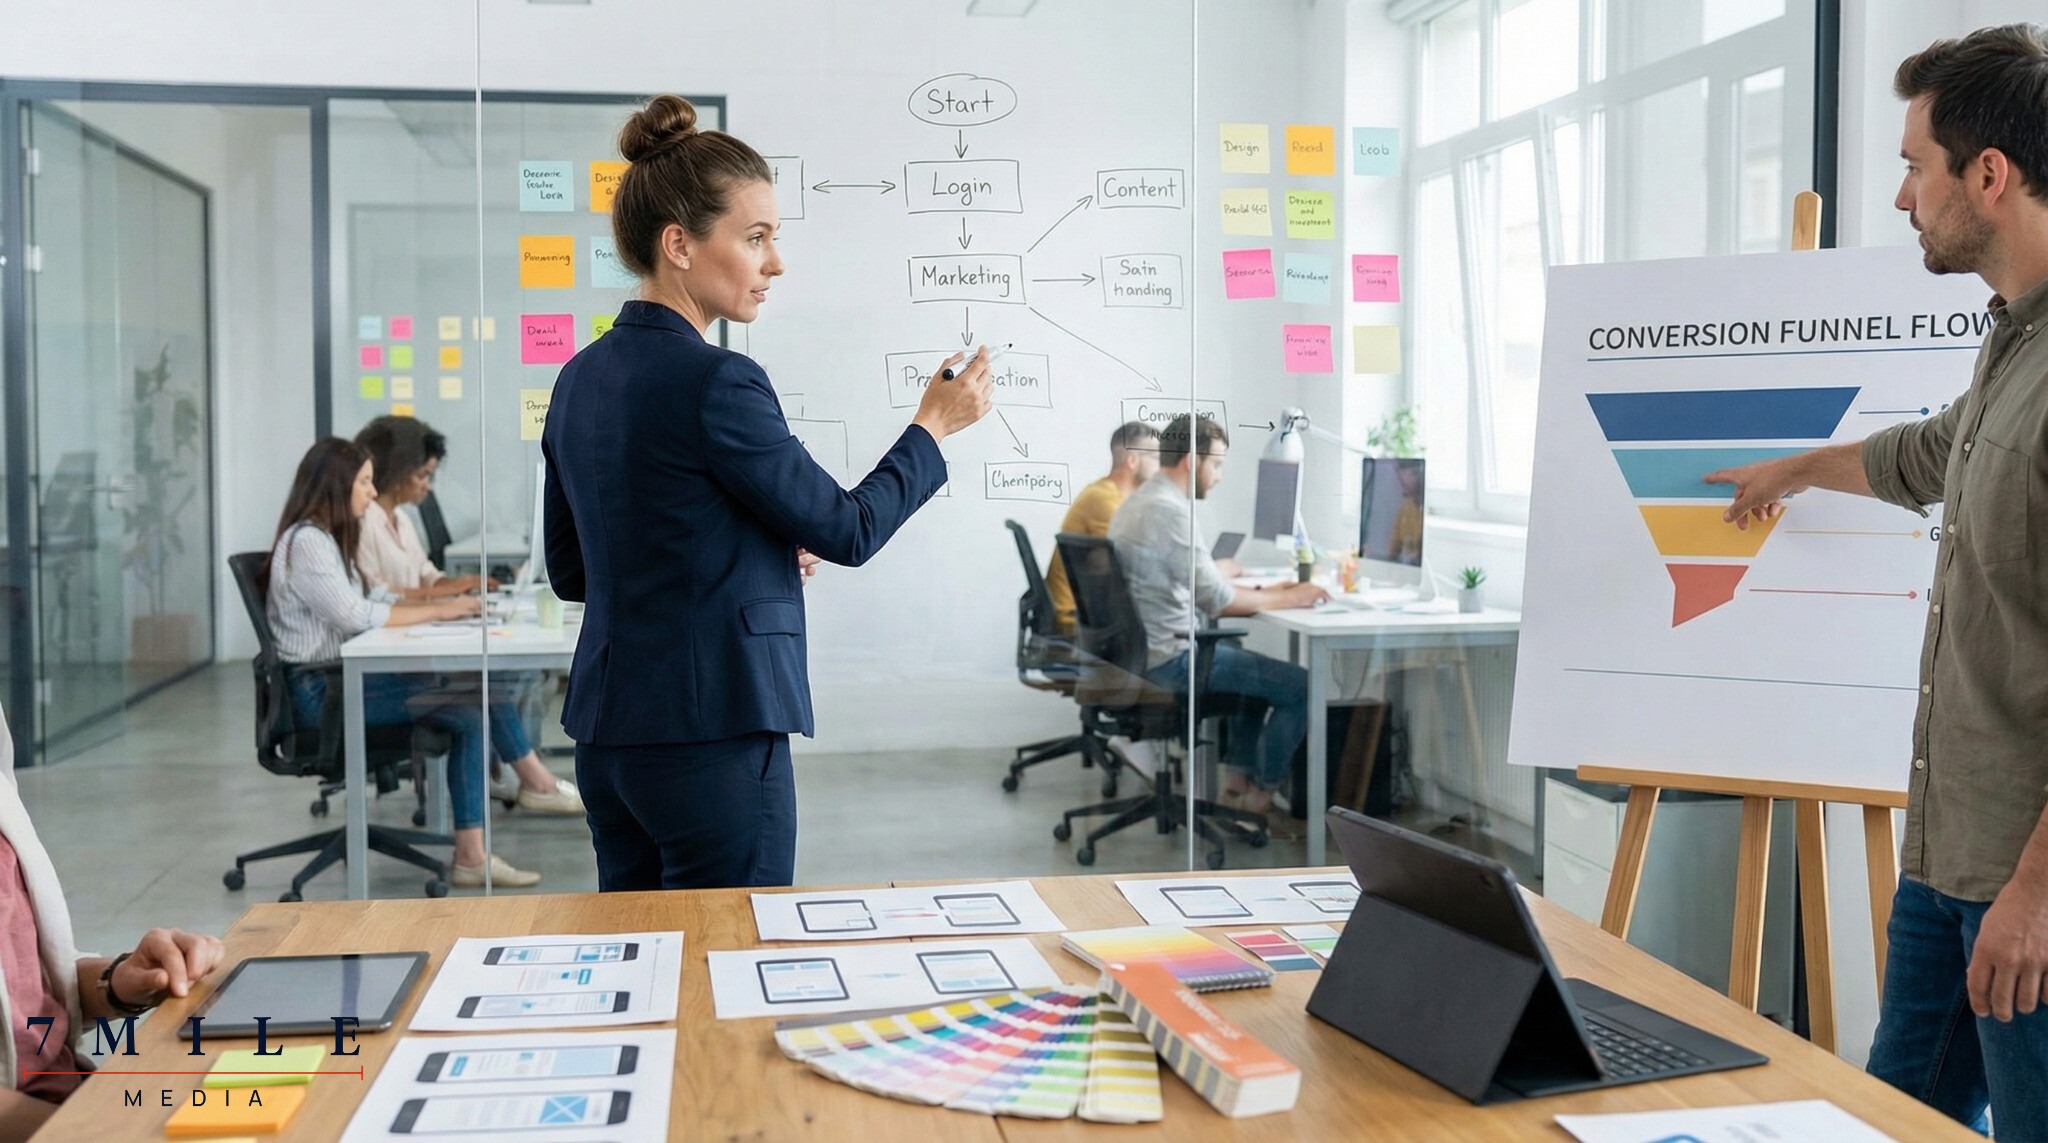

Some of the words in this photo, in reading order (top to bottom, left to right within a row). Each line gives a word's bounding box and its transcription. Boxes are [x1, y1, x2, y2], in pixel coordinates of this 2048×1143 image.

[927, 88, 995, 115] Start
[932, 171, 992, 206] Login
[1103, 176, 1177, 198] Content
[922, 264, 1011, 298] Marketing
[1120, 259, 1157, 276] Sain
[1589, 321, 1770, 350] CONVERSION
[1780, 316, 1900, 343] FUNNEL
